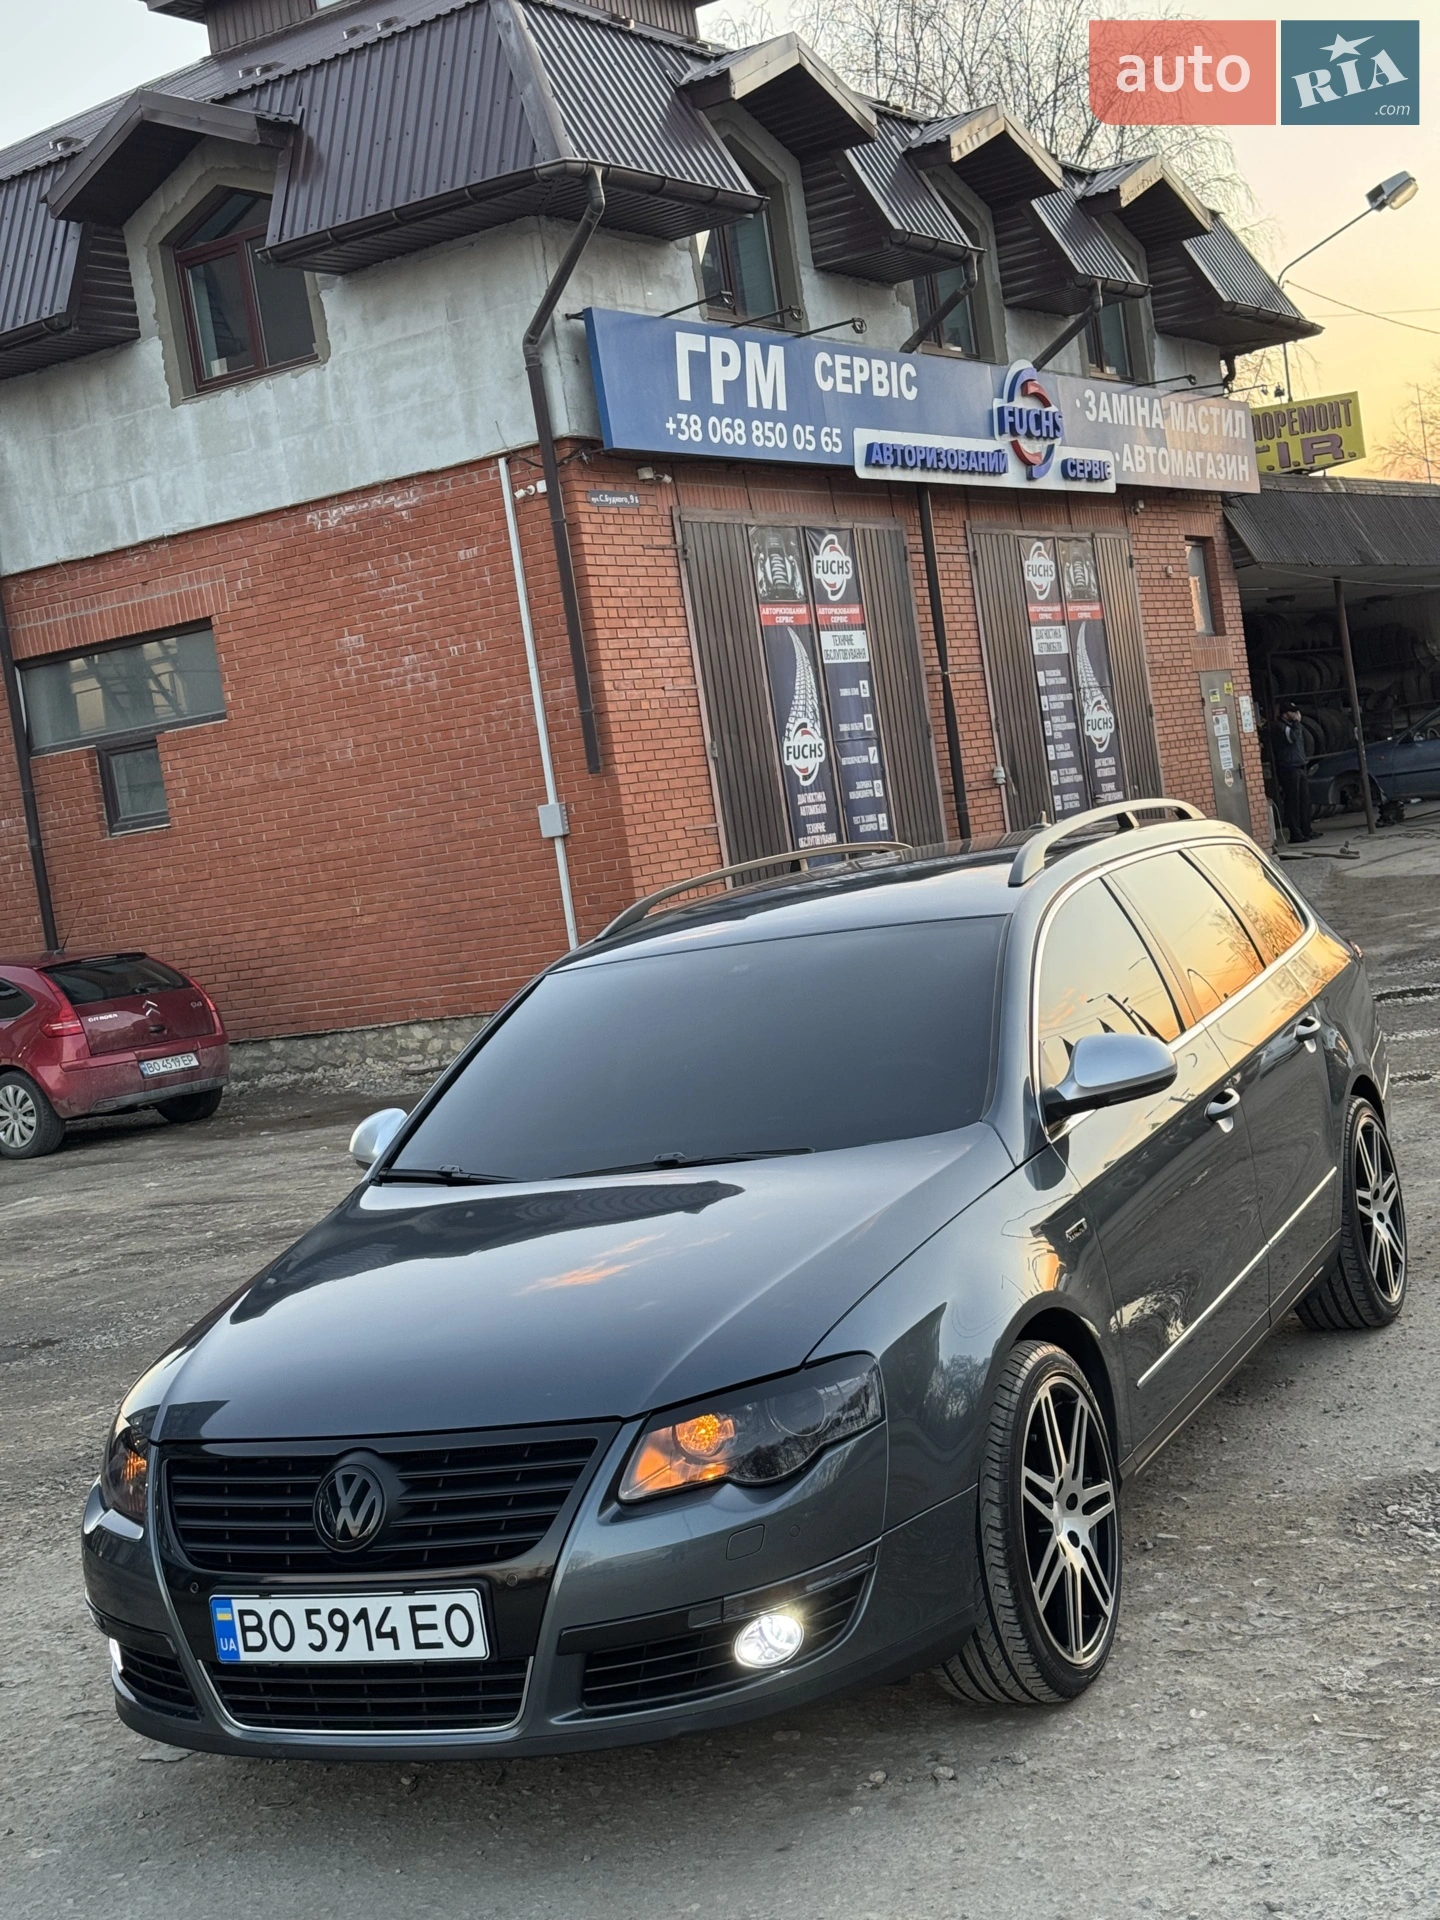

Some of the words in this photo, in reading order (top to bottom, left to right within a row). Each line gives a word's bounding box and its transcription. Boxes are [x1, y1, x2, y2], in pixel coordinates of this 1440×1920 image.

[675, 331, 787, 411] ГРМ
[814, 352, 918, 401] СЕРВІС
[1000, 405, 1063, 439] FUCHS
[1083, 389, 1165, 430] ЗАМІНА
[1170, 403, 1246, 439] МАСТИЛ
[665, 413, 703, 442] +38
[708, 416, 746, 446] 068
[751, 420, 788, 449] 850
[792, 424, 816, 452] 05
[820, 427, 843, 453] 65
[865, 441, 1008, 475] АВТОРИЗОВАНИЙ
[1061, 456, 1112, 481] СЕРВІС
[1121, 442, 1250, 482] АВТОМАГАЗИН
[815, 560, 850, 575] FUCHS
[1026, 564, 1054, 578] FUCHS
[1086, 717, 1113, 732] FUCHS
[786, 743, 823, 761] FUCHS
[220, 1638, 237, 1651] UA
[237, 1609, 295, 1652] BO
[304, 1606, 400, 1652] 5914
[408, 1603, 474, 1650] EO
